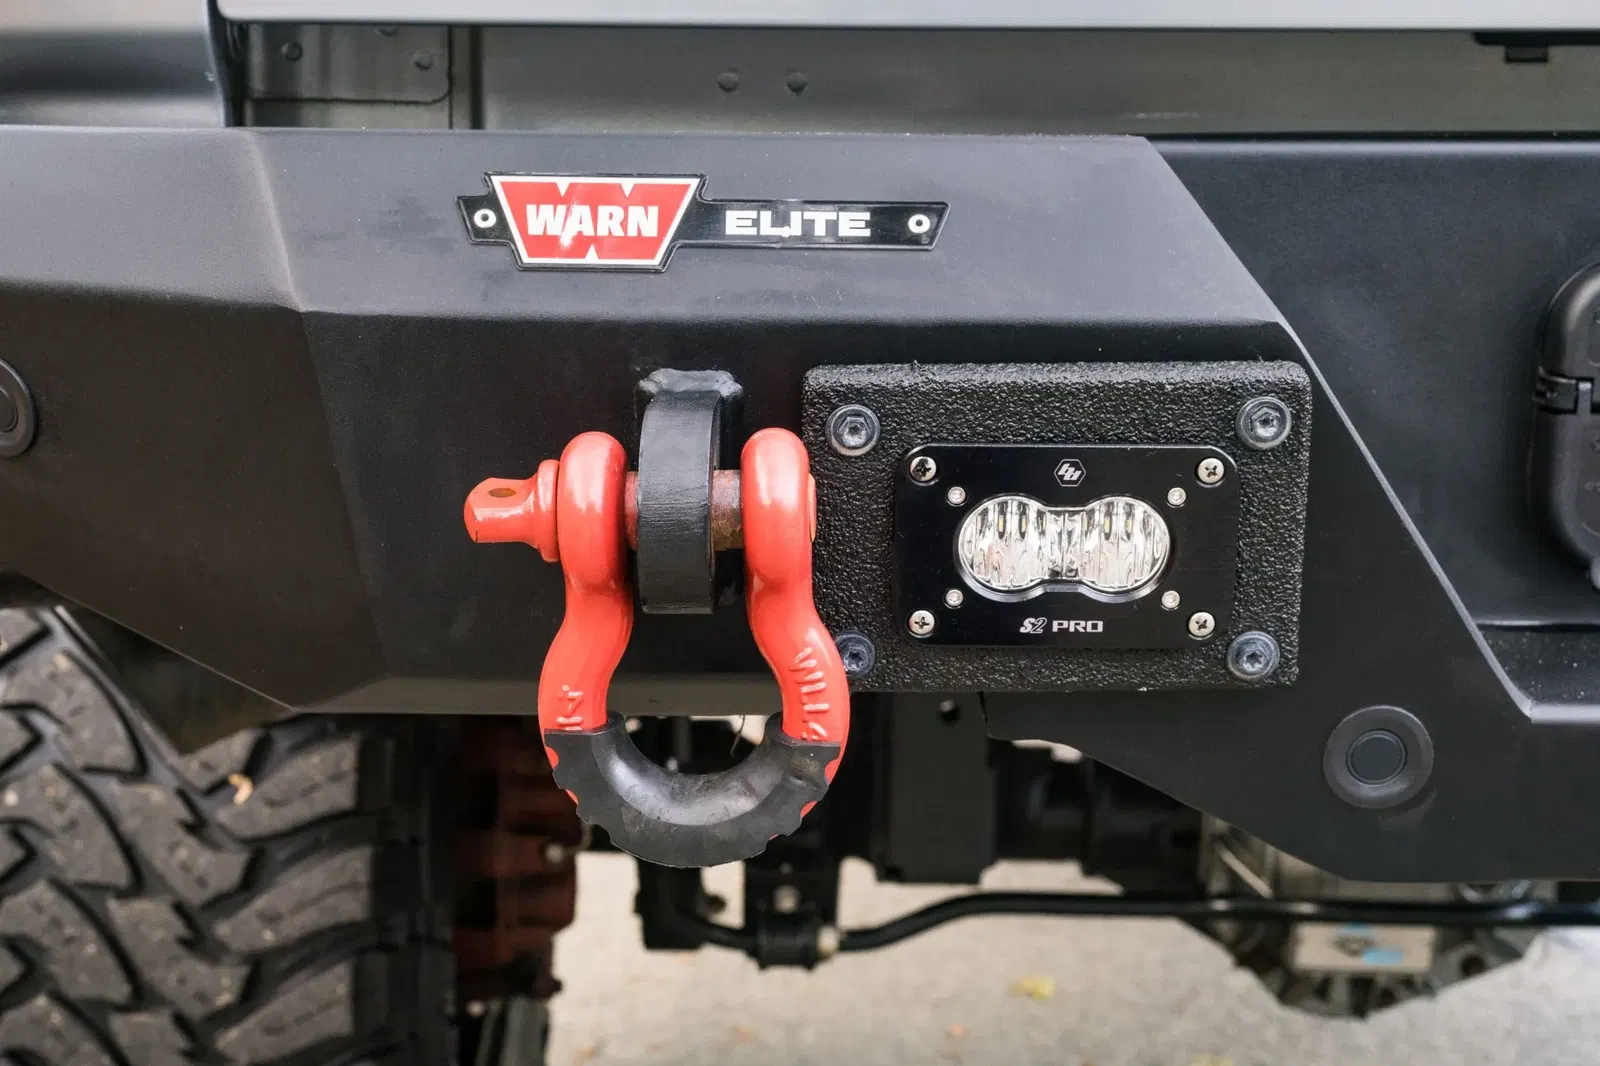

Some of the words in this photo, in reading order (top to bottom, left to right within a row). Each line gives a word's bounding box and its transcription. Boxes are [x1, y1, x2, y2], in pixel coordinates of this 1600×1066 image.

[526, 203, 659, 238] WARN
[724, 209, 872, 237] ELITE
[1019, 616, 1048, 634] S2
[1051, 619, 1104, 633] PRO
